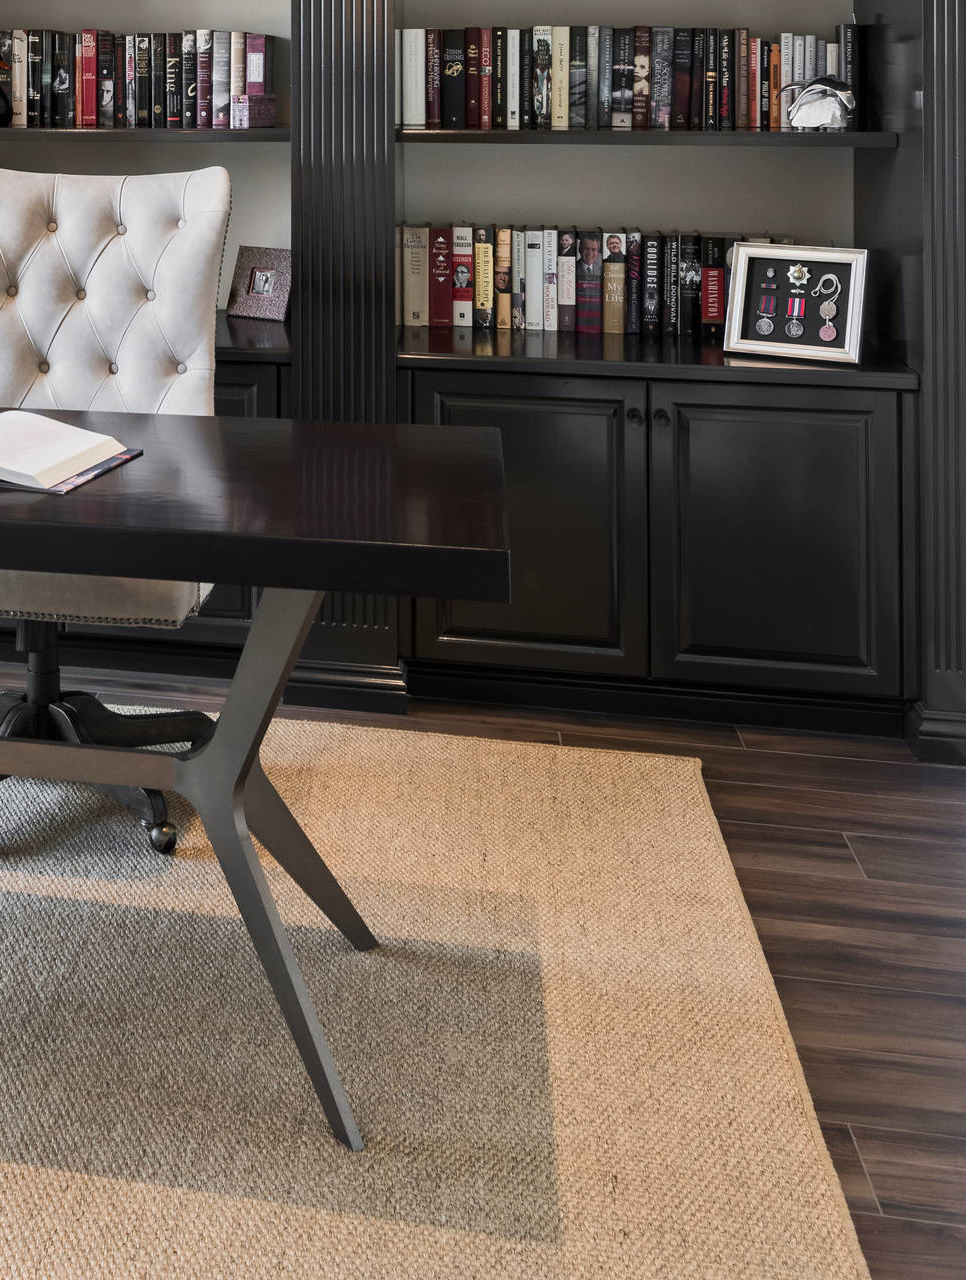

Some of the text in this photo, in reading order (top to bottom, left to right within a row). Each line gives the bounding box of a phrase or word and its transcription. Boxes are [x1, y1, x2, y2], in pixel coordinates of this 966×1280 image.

[481, 47, 490, 66] ECO
[165, 57, 181, 93] King
[646, 241, 658, 289] COOLIDGE
[670, 264, 678, 283] BILL
[483, 280, 491, 303] PULPIT
[605, 294, 624, 302] Life
[608, 282, 622, 293] My
[707, 270, 719, 317] WASHINGTON
